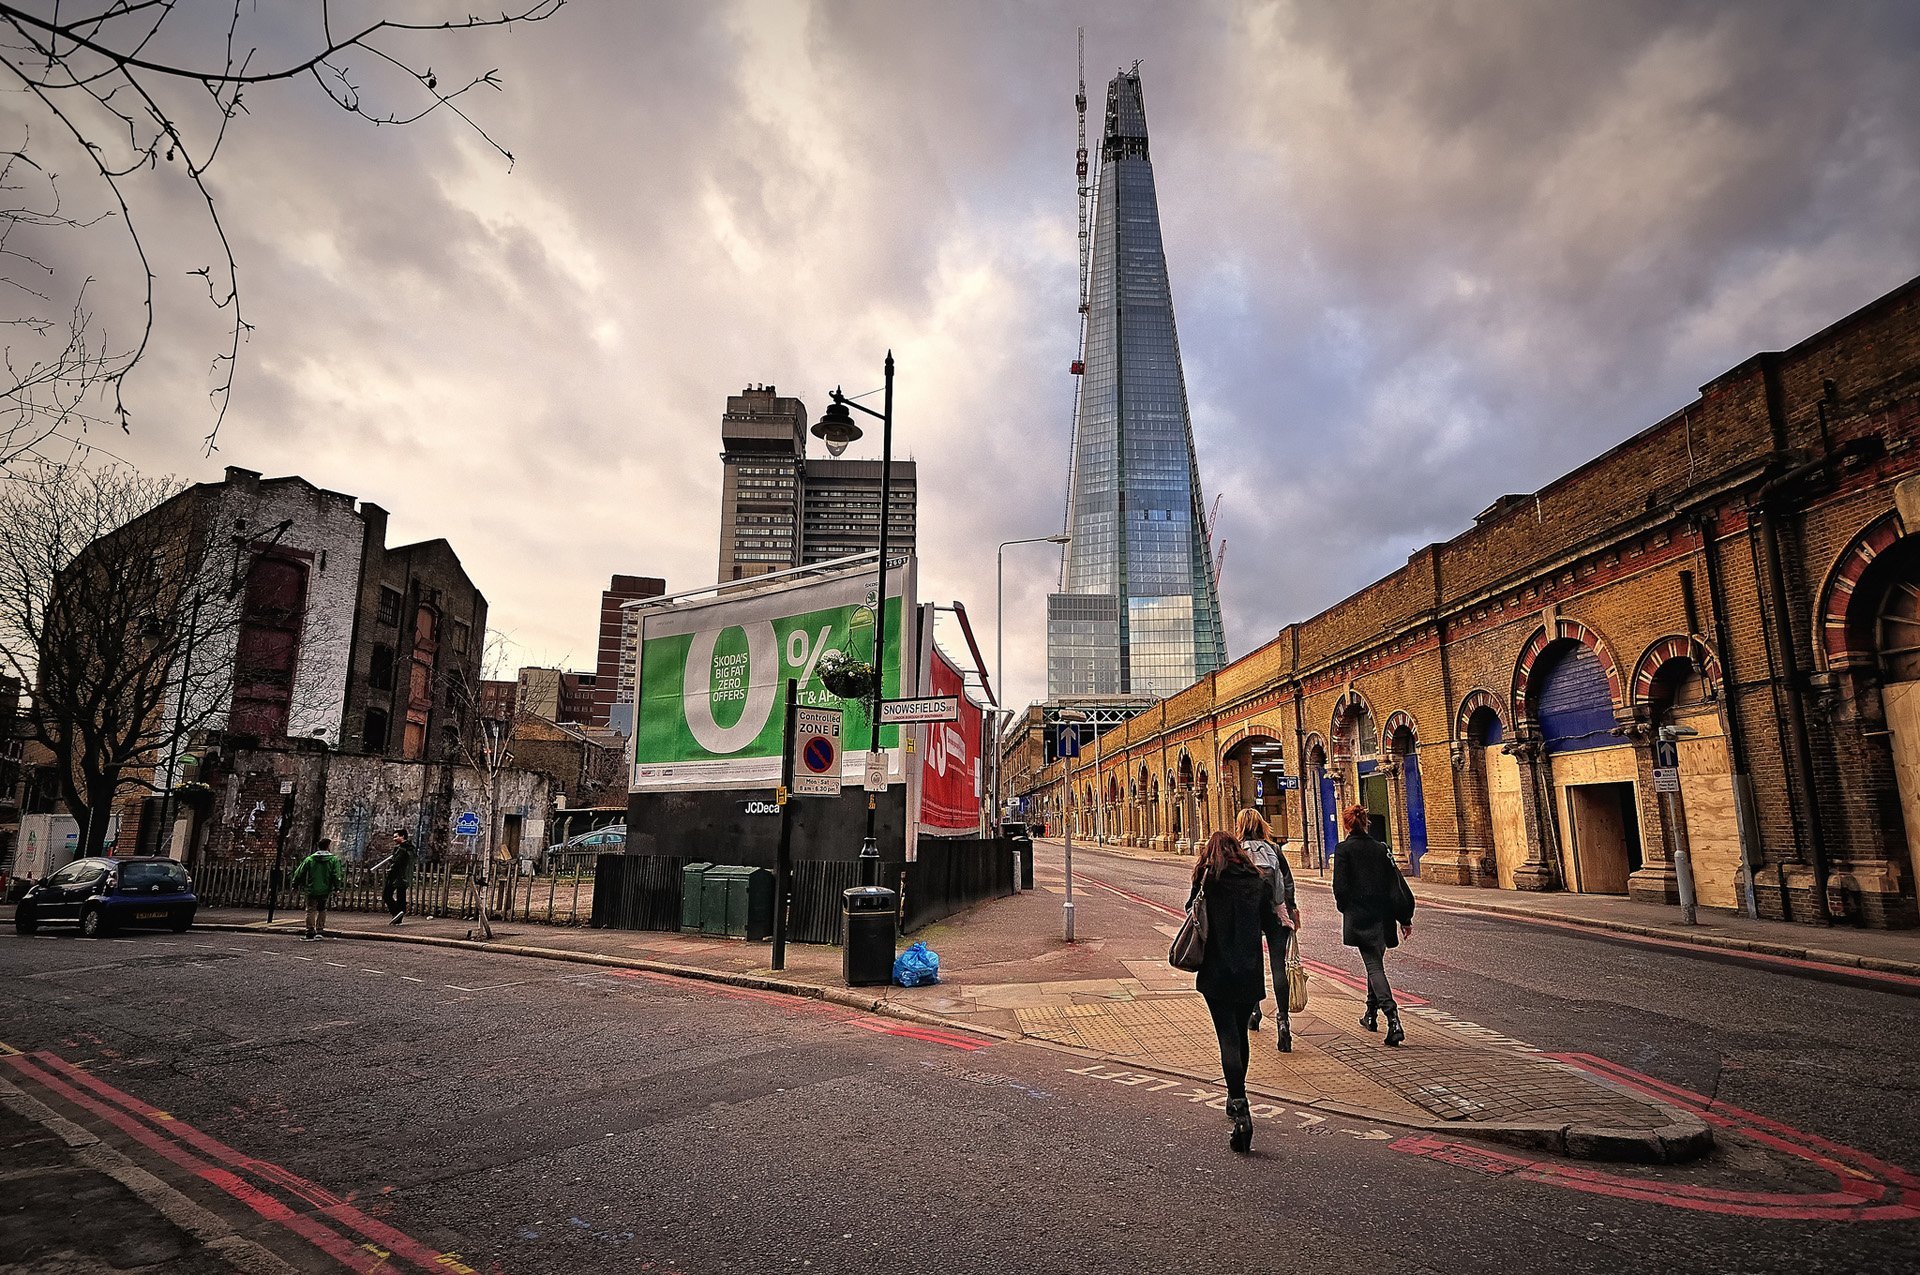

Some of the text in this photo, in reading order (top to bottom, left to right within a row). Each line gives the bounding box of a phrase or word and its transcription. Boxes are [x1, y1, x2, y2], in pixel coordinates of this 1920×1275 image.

[713, 653, 748, 668] ŠKODA'S
[715, 665, 745, 679] BIG FAT
[718, 679, 741, 690] ZERO
[713, 689, 745, 702] OFFERS
[808, 690, 816, 704] &
[883, 702, 946, 715] SNOWSFIELDS
[800, 711, 840, 723] Controlled
[799, 723, 839, 736] ZONE F
[745, 802, 780, 814] JCDeca
[1065, 1066, 1182, 1092] LEFT
